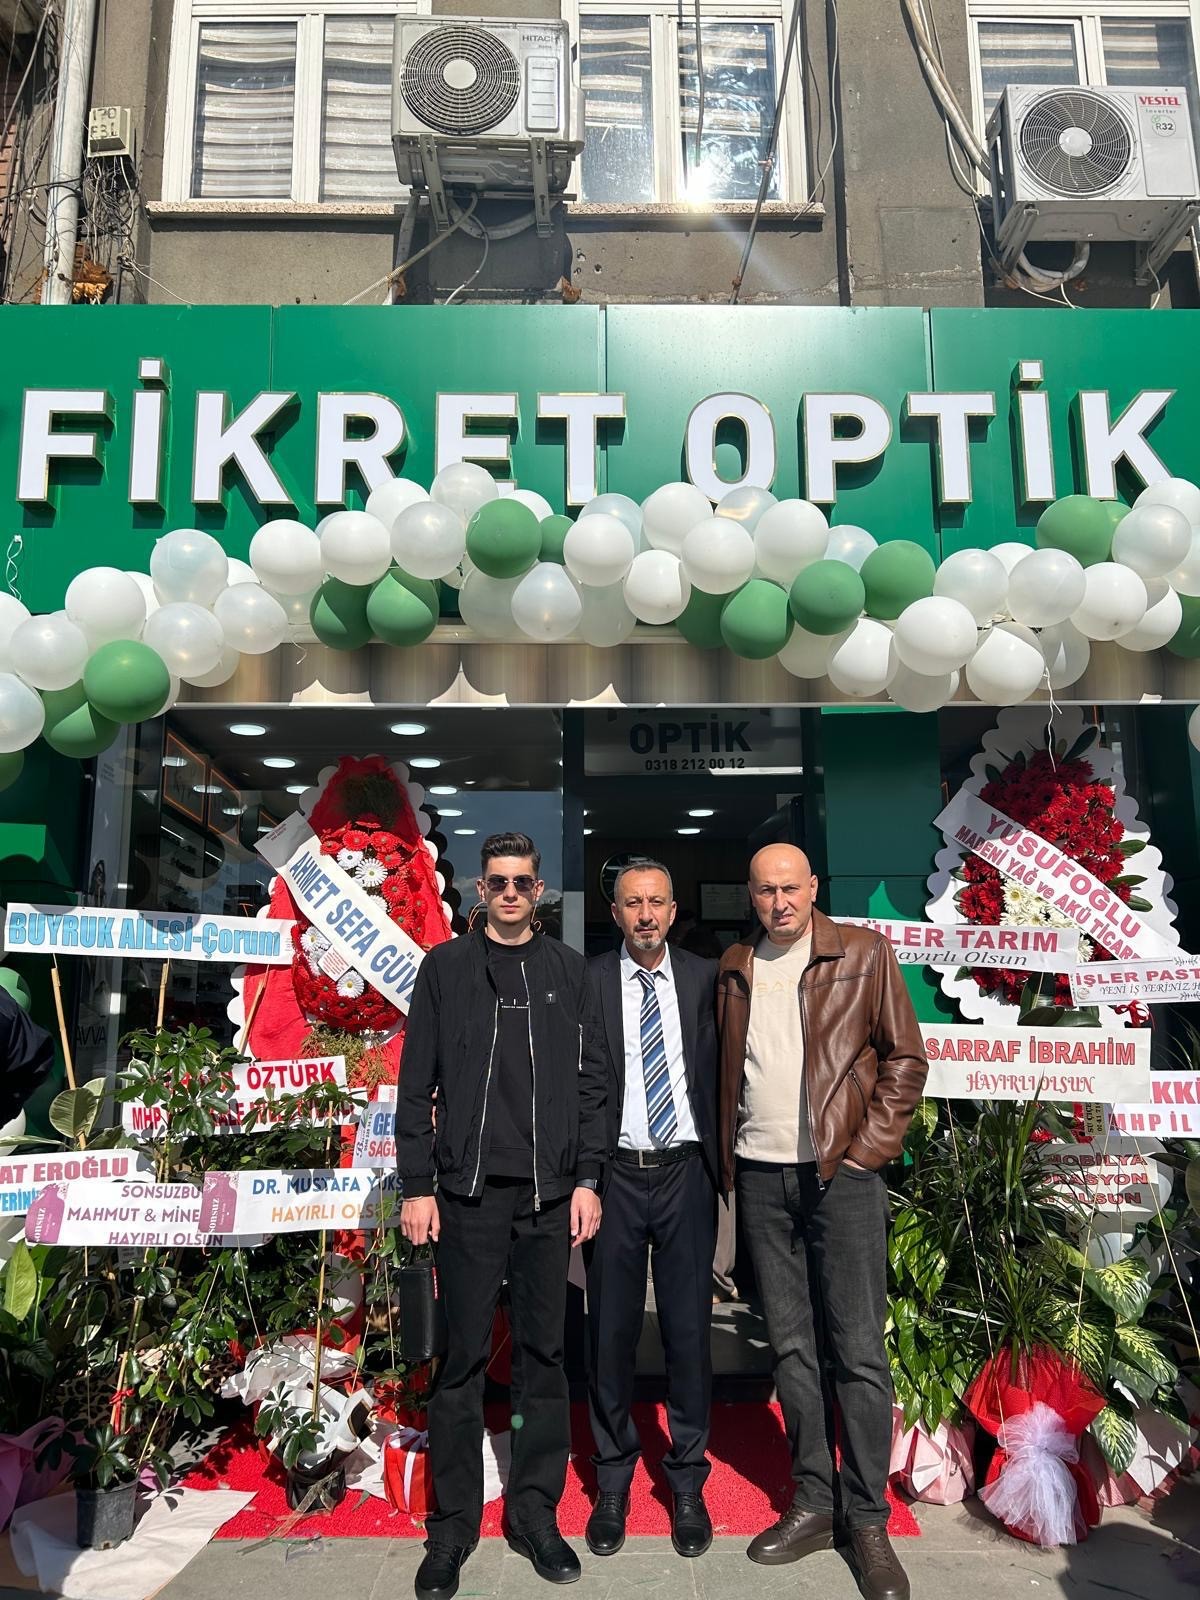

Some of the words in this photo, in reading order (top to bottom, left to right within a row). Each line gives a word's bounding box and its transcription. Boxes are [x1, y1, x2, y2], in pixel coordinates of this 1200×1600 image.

[1139, 96, 1181, 105] VESTEL
[1155, 122, 1174, 130] R32
[15, 357, 626, 508] FİKRET
[684, 359, 1178, 504] OPTİK
[629, 713, 752, 754] OPTİK
[645, 759, 678, 771] 0318
[682, 759, 705, 770] 212
[709, 758, 725, 769] 00
[729, 758, 745, 768] 12
[954, 825, 1009, 866] MADENİ
[1006, 857, 1039, 886] YAĞ
[1036, 881, 1055, 899] ve
[1053, 893, 1092, 923] AKÜ
[987, 813, 1142, 938] YUSUFOĞLU
[8, 911, 116, 949] BUYRUK
[118, 913, 281, 958] AİLESİ-Çorum
[289, 850, 342, 910] AHMET
[325, 899, 381, 958] SEFA
[370, 945, 420, 1004] GÜV
[956, 930, 1058, 953] TARIM
[894, 948, 956, 965] ayırlı
[964, 951, 1027, 966] Olsun
[1076, 971, 1139, 987] İŞLER
[1100, 984, 1127, 995] YENİ
[925, 1037, 1022, 1062] SARRAF
[1029, 1035, 1136, 1066] İBRAHİM
[246, 1057, 337, 1090] ÖZTÜRK
[966, 1070, 1036, 1094] HAYIRLI
[1039, 1075, 1096, 1095] OLSUN
[132, 1106, 161, 1130] MHP
[1108, 1113, 1161, 1132] MHP
[1170, 1110, 1192, 1132] İL
[33, 1156, 129, 1182] EROĞLU
[252, 1178, 281, 1195] DR.
[286, 1176, 361, 1194] MUSTAFA
[67, 1206, 140, 1222] MAHMUT
[144, 1208, 157, 1223] &
[162, 1205, 200, 1223] MİNE
[271, 1204, 335, 1223] HAYIRLI
[342, 1202, 381, 1221] OLS
[108, 1232, 168, 1245] HAYIRLI
[173, 1232, 223, 1246] OLSUN
